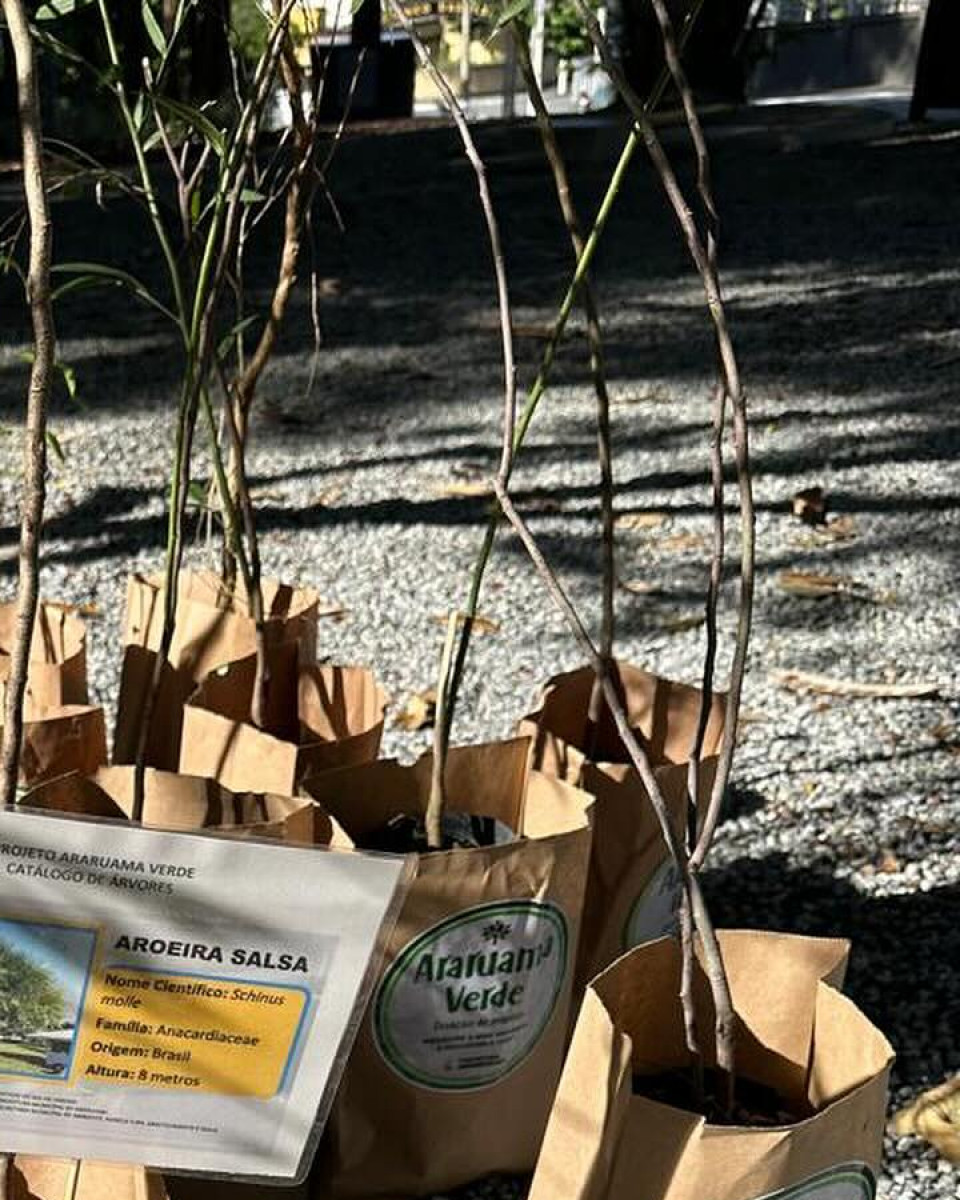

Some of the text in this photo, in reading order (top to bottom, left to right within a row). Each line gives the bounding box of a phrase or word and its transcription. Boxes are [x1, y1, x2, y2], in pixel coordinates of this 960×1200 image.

[60, 848, 145, 873] ARARUAMA
[149, 863, 196, 879] VERDE
[87, 873, 104, 885] DE
[115, 935, 309, 973] AROEIRA SALSA
[100, 994, 142, 1009] molle
[105, 973, 150, 991] Nome
[232, 988, 285, 1006] Schinus
[445, 981, 524, 1014] Verde
[156, 1024, 260, 1047] Anacardiaceae
[90, 1040, 191, 1063] Origem: Brasil
[85, 1063, 201, 1087] Altura: 8 metros
